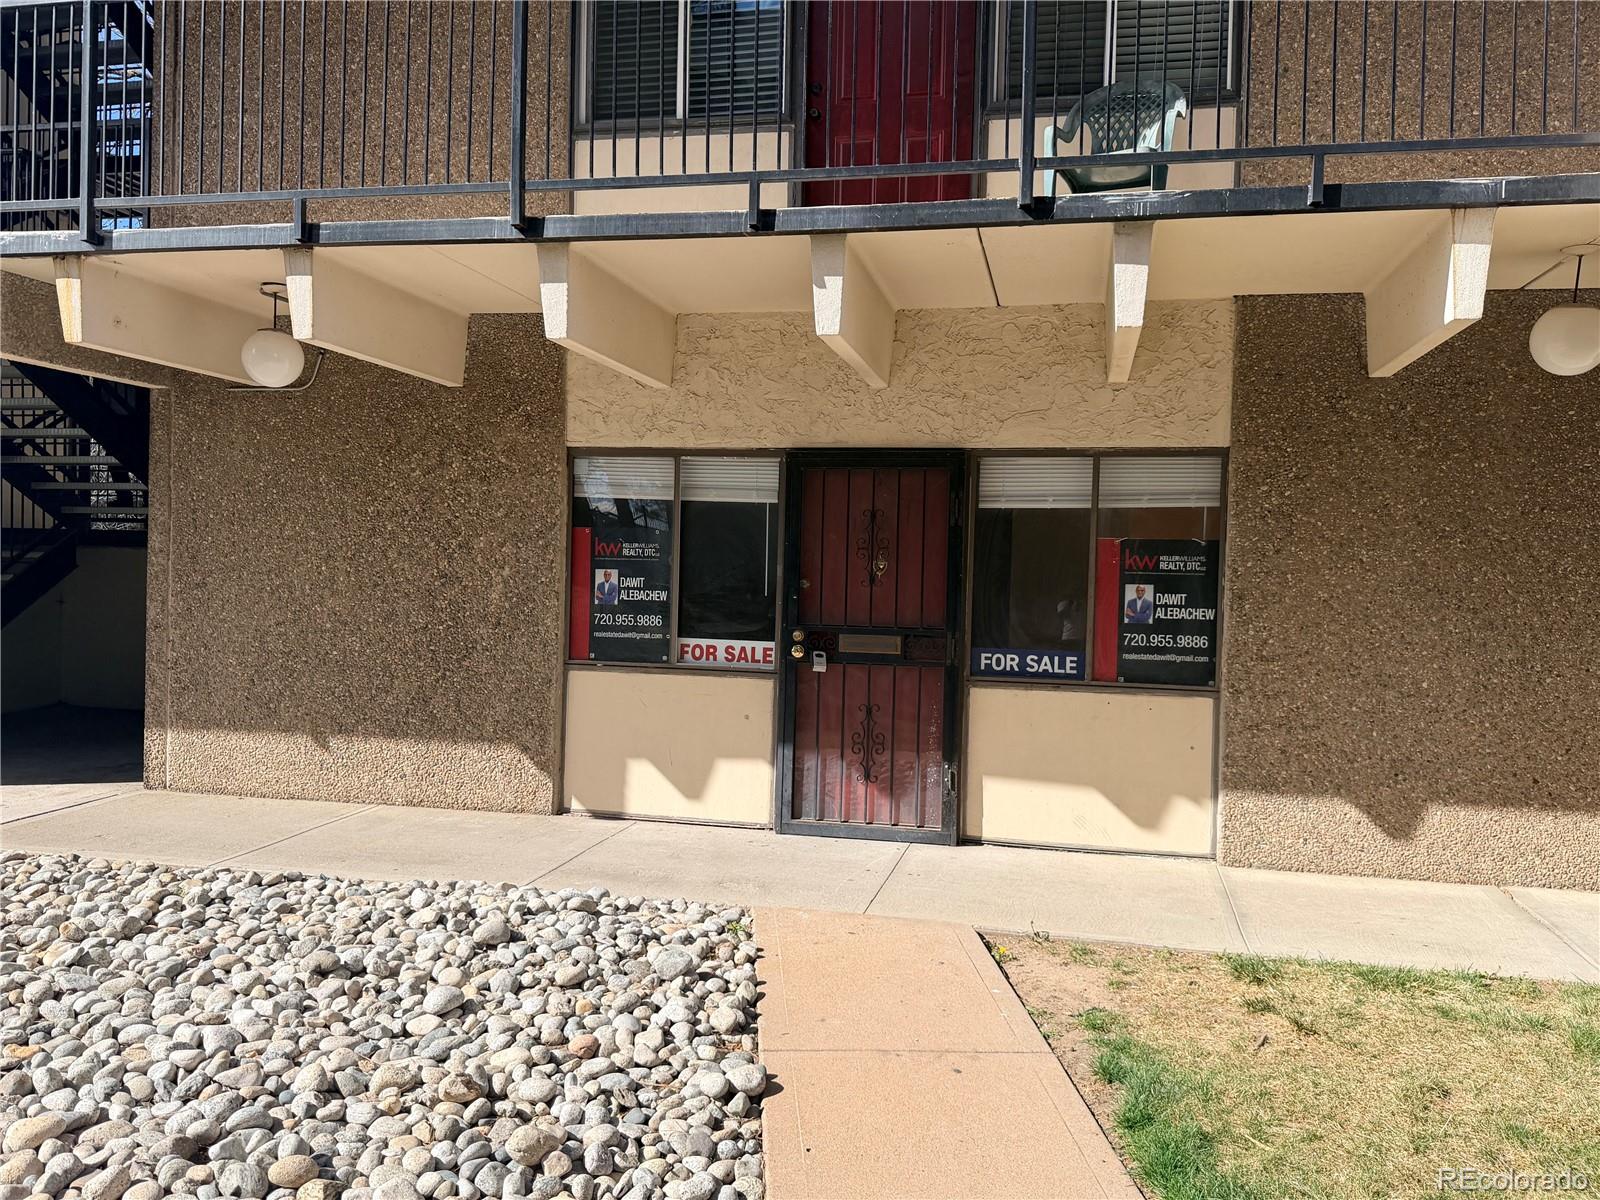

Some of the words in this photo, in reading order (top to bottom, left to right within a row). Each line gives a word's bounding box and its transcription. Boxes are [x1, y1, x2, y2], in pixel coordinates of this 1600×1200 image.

[595, 537, 622, 556] kw
[622, 548, 644, 557] REALTY,
[1125, 548, 1159, 570] kw
[1159, 561, 1185, 572] REALTY,
[1186, 562, 1201, 571] DTC
[620, 577, 645, 588] DAWIT
[619, 590, 668, 601] ALEBACHEW
[1156, 593, 1187, 605] DAWIT
[594, 613, 662, 627] 720.955.9886
[1155, 607, 1216, 621] ALEBACHEW
[1123, 633, 1209, 649] 720.955.9886
[680, 643, 717, 661] FOR
[724, 645, 774, 665] SALE
[980, 653, 1019, 672] FOR
[1026, 655, 1078, 674] SALE
